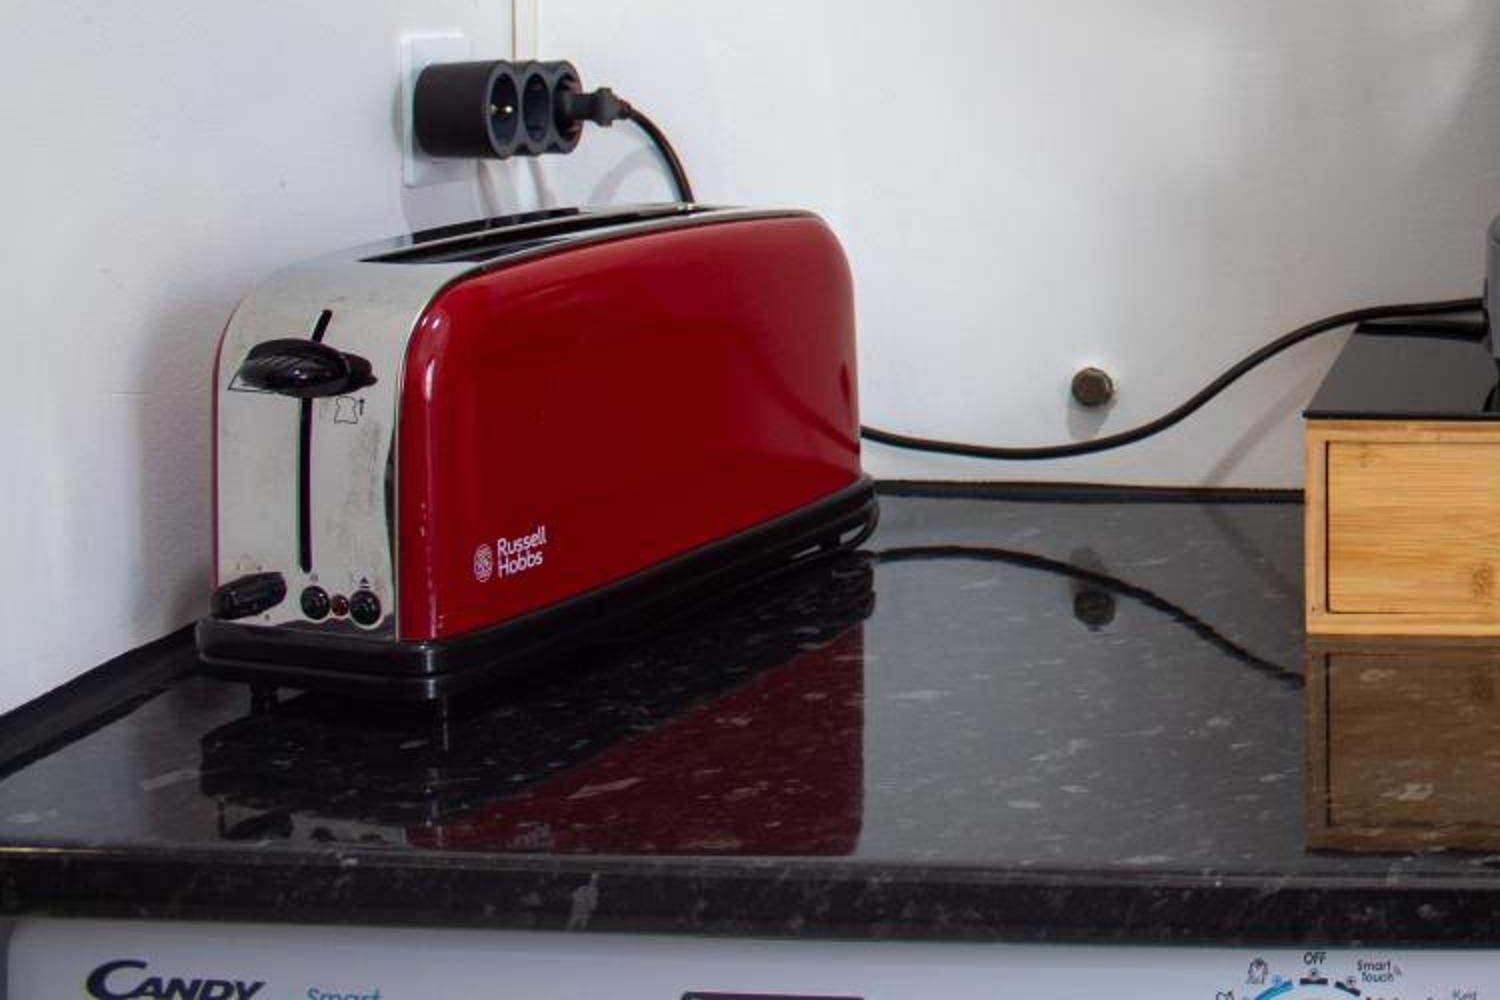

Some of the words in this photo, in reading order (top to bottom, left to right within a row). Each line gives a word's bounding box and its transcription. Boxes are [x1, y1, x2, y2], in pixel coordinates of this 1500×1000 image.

[497, 525, 547, 557] Russell
[498, 551, 544, 578] Hobbs
[1303, 952, 1327, 965] OFF
[1357, 960, 1392, 972] Smart
